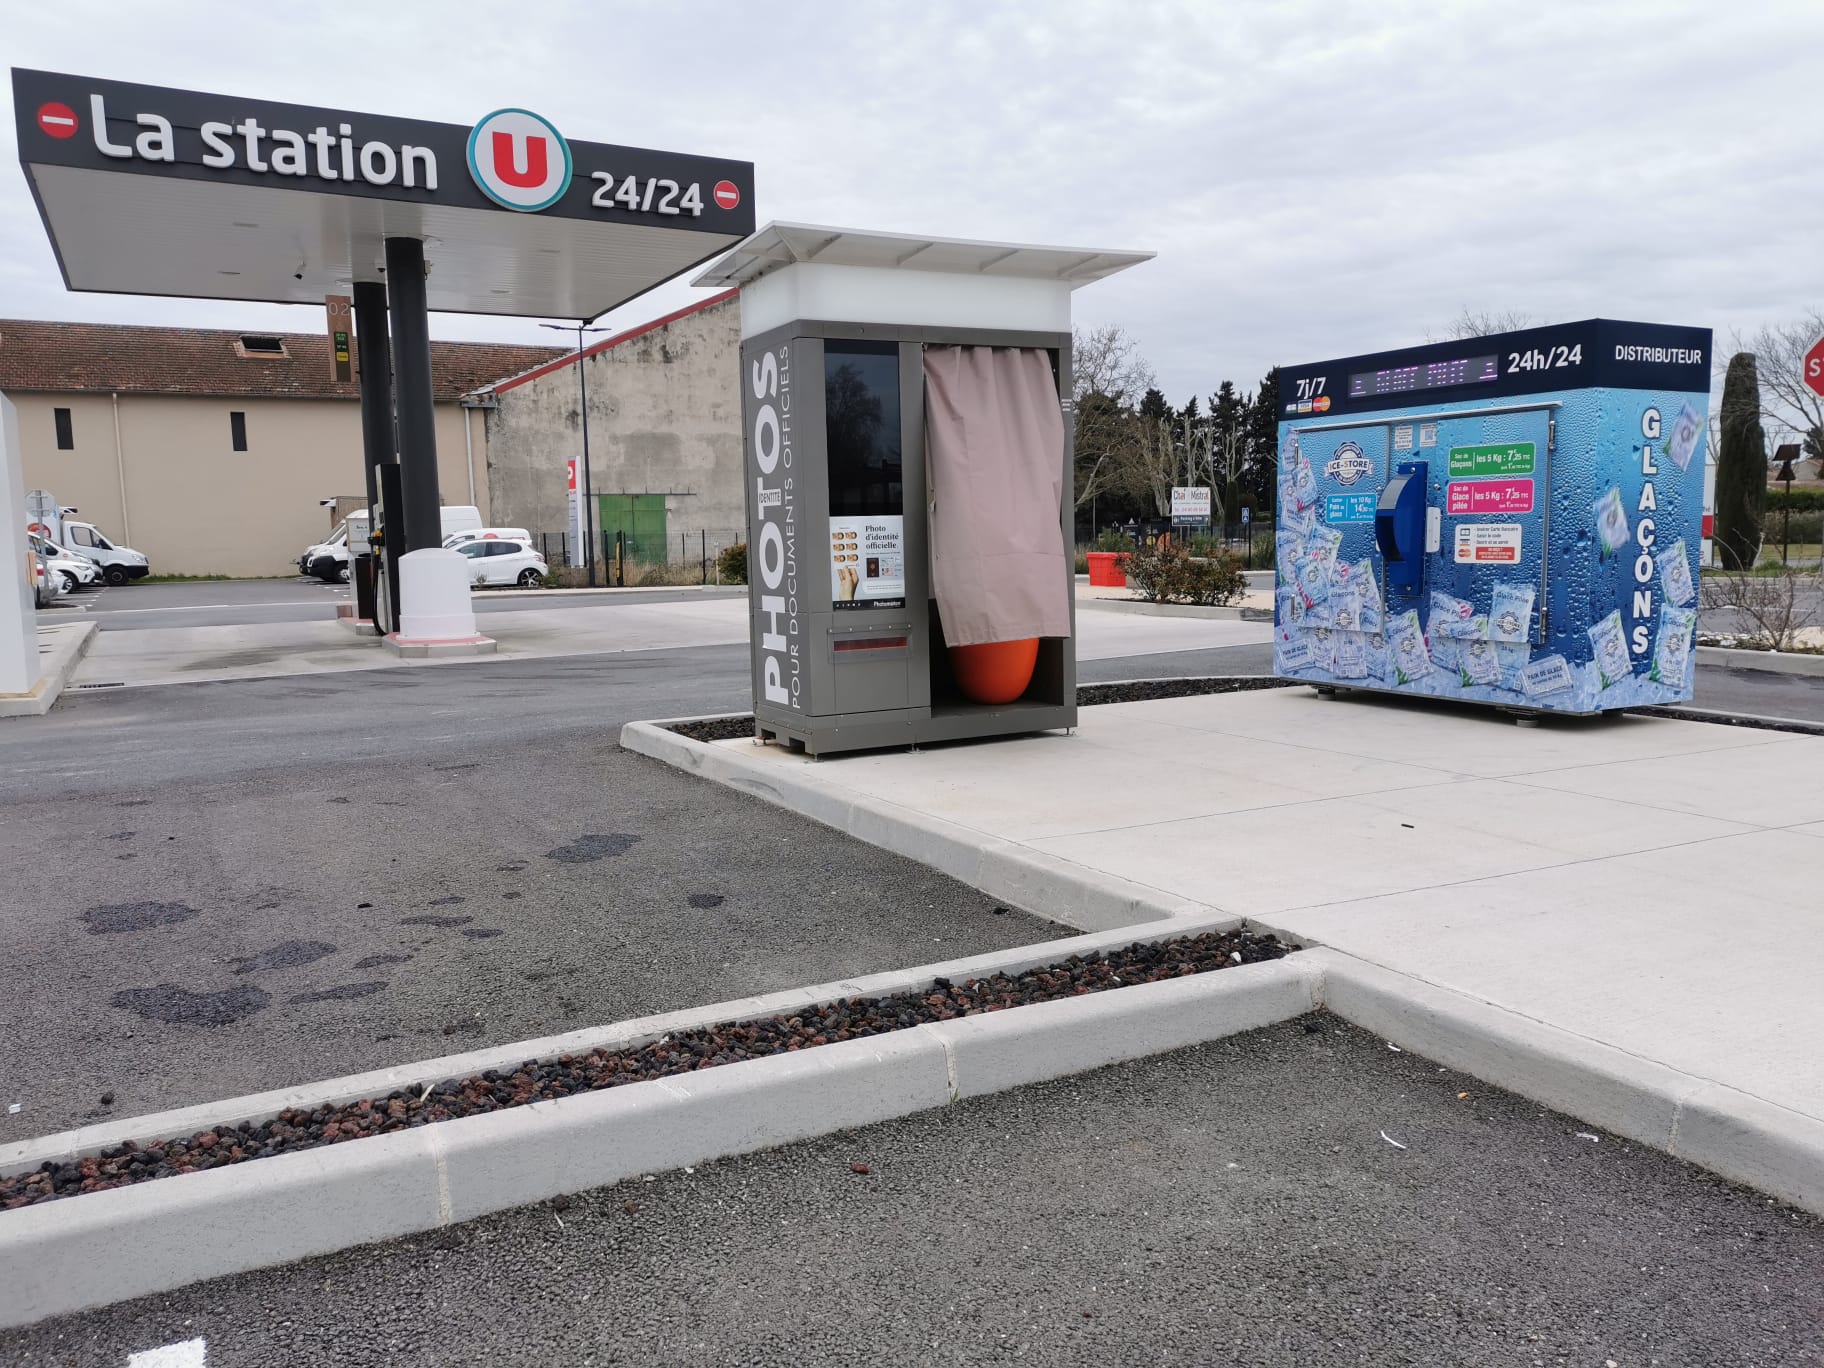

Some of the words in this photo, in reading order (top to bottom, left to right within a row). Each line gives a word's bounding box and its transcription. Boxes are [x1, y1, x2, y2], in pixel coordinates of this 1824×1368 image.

[90, 94, 175, 162] La
[201, 116, 438, 191] station
[492, 131, 549, 188] U
[591, 171, 705, 217] 24/24
[328, 302, 350, 316] 02
[1507, 344, 1582, 373] 24h/24
[1615, 345, 1702, 364] DISTRIBUTEUR
[1809, 358, 1824, 377] S
[1296, 377, 1327, 399] 7j/7
[780, 346, 792, 469] OFFICIELS
[1329, 459, 1368, 471] ICE-STORE
[1476, 455, 1486, 463] les
[1493, 454, 1502, 463] Kg
[1474, 492, 1484, 500] les
[1491, 491, 1500, 501] Kg
[753, 352, 788, 705] PHOTOS
[865, 533, 899, 541] d'identité
[1631, 408, 1661, 654] GLAÇONS
[784, 477, 798, 635] DOCUMENTS
[790, 644, 801, 709] POUR
